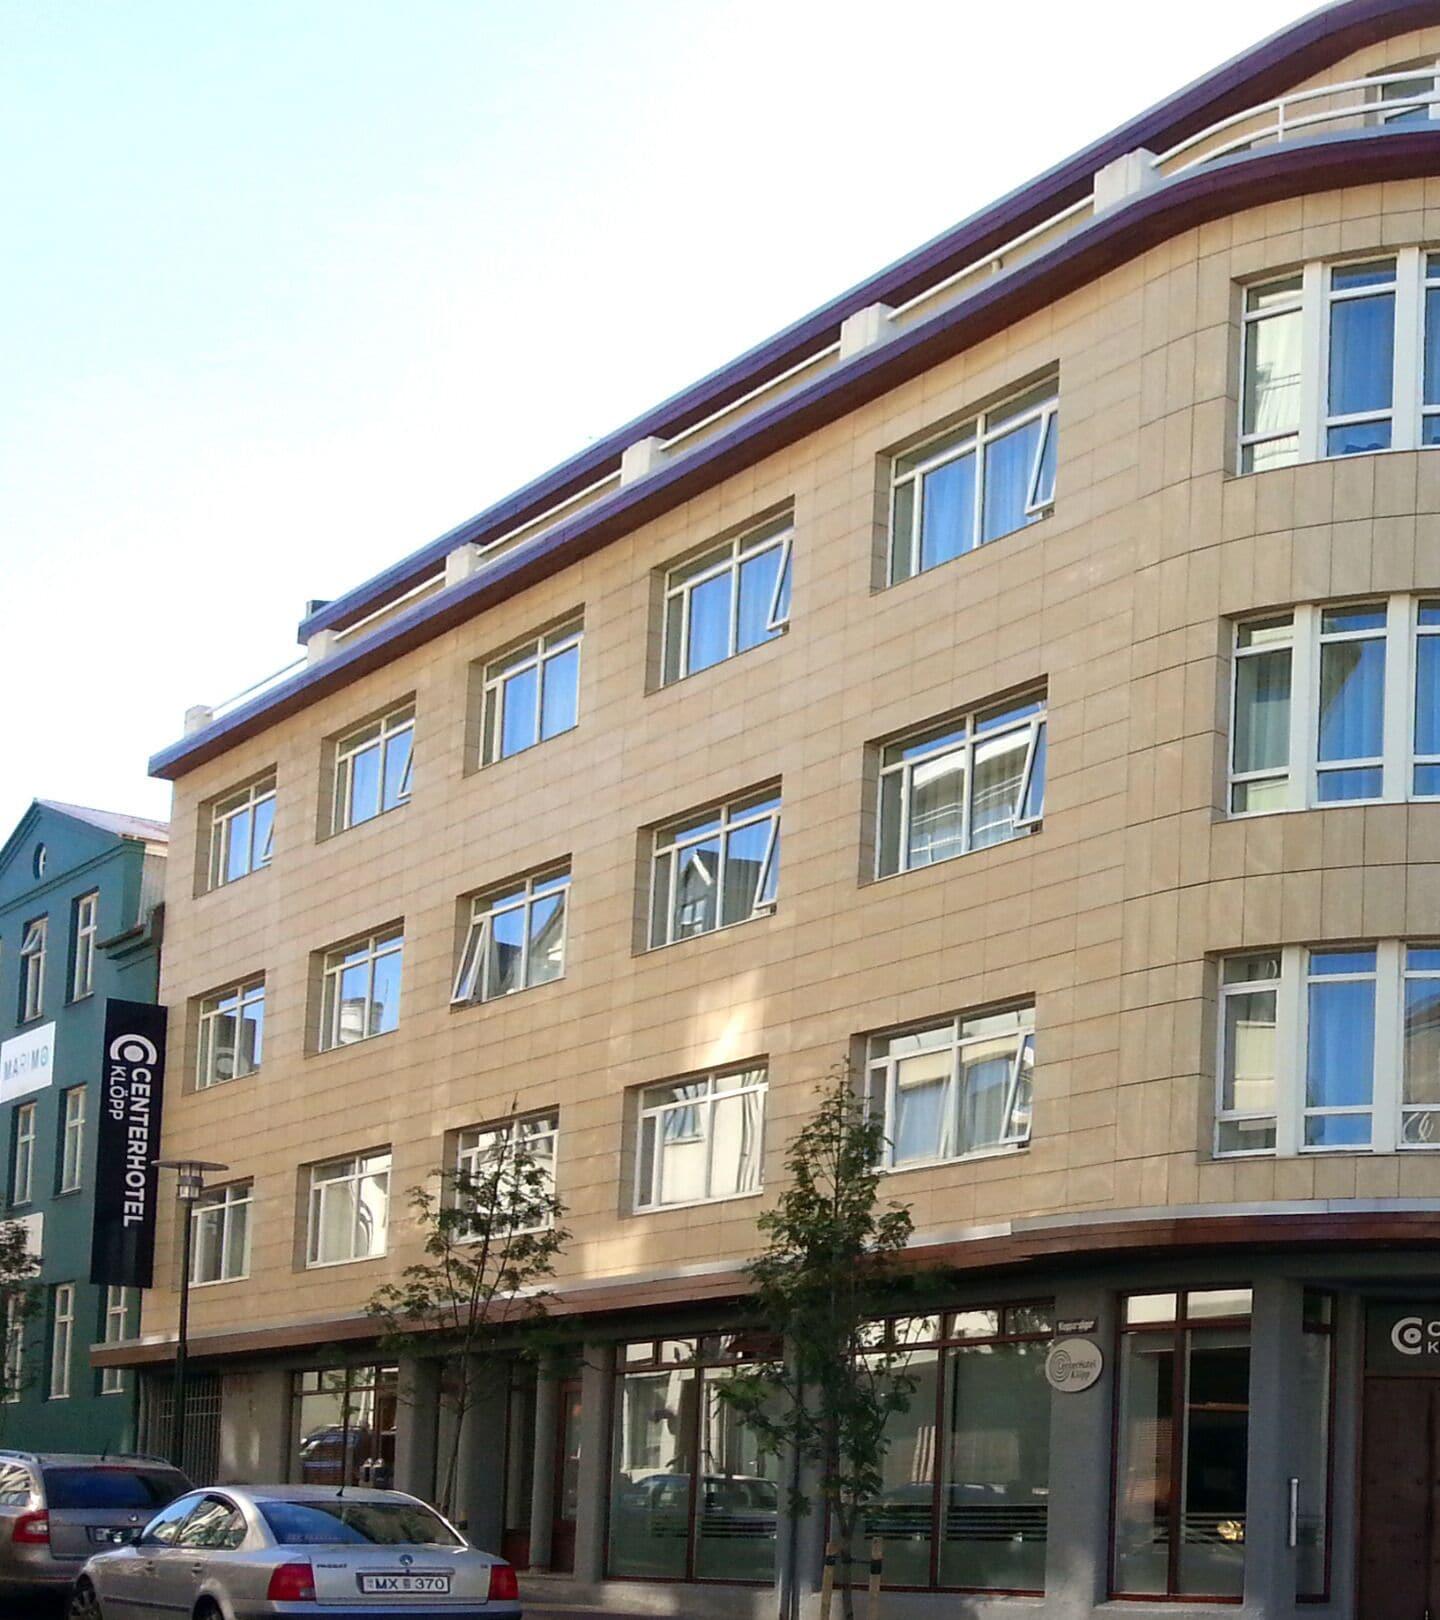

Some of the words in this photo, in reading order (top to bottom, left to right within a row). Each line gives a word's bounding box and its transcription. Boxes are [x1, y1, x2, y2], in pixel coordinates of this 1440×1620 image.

[108, 1064, 128, 1120] KLÖPP
[123, 1067, 152, 1227] CENTERHOTEL
[375, 1578, 399, 1590] MX
[415, 1577, 445, 1590] 370
